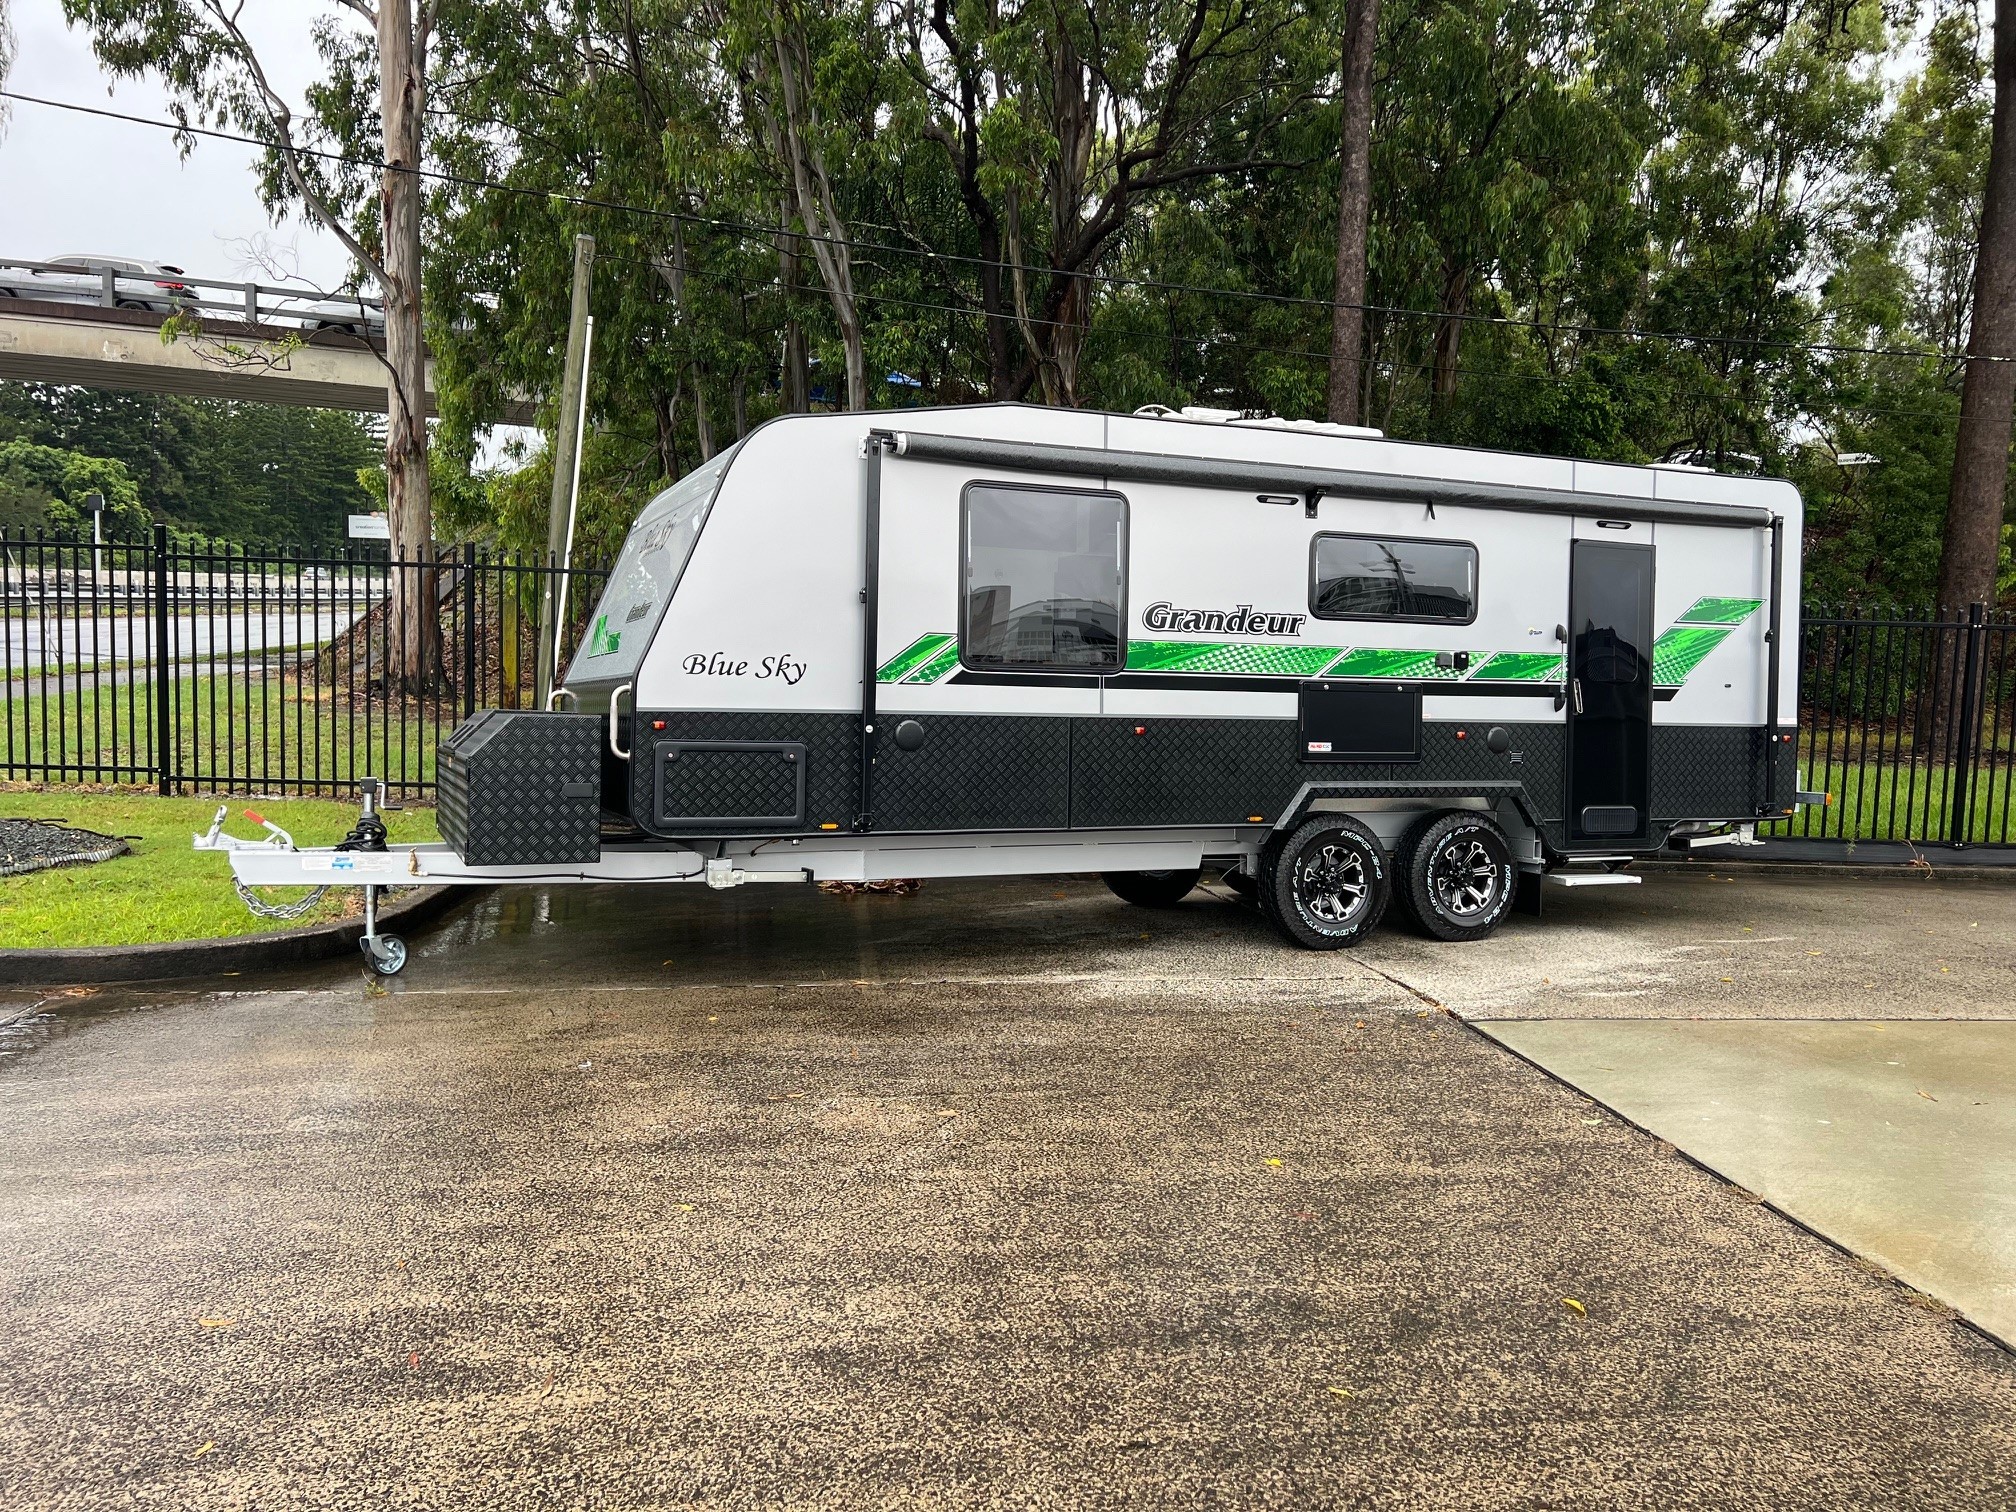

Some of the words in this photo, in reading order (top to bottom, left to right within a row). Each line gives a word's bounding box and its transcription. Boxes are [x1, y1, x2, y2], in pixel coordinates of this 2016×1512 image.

[1142, 601, 1306, 636] Grandeur
[682, 651, 748, 676] Blue
[754, 653, 807, 686] Sky
[1426, 832, 1453, 915] ADVENTURE
[1292, 891, 1359, 937] ADVENTURE
